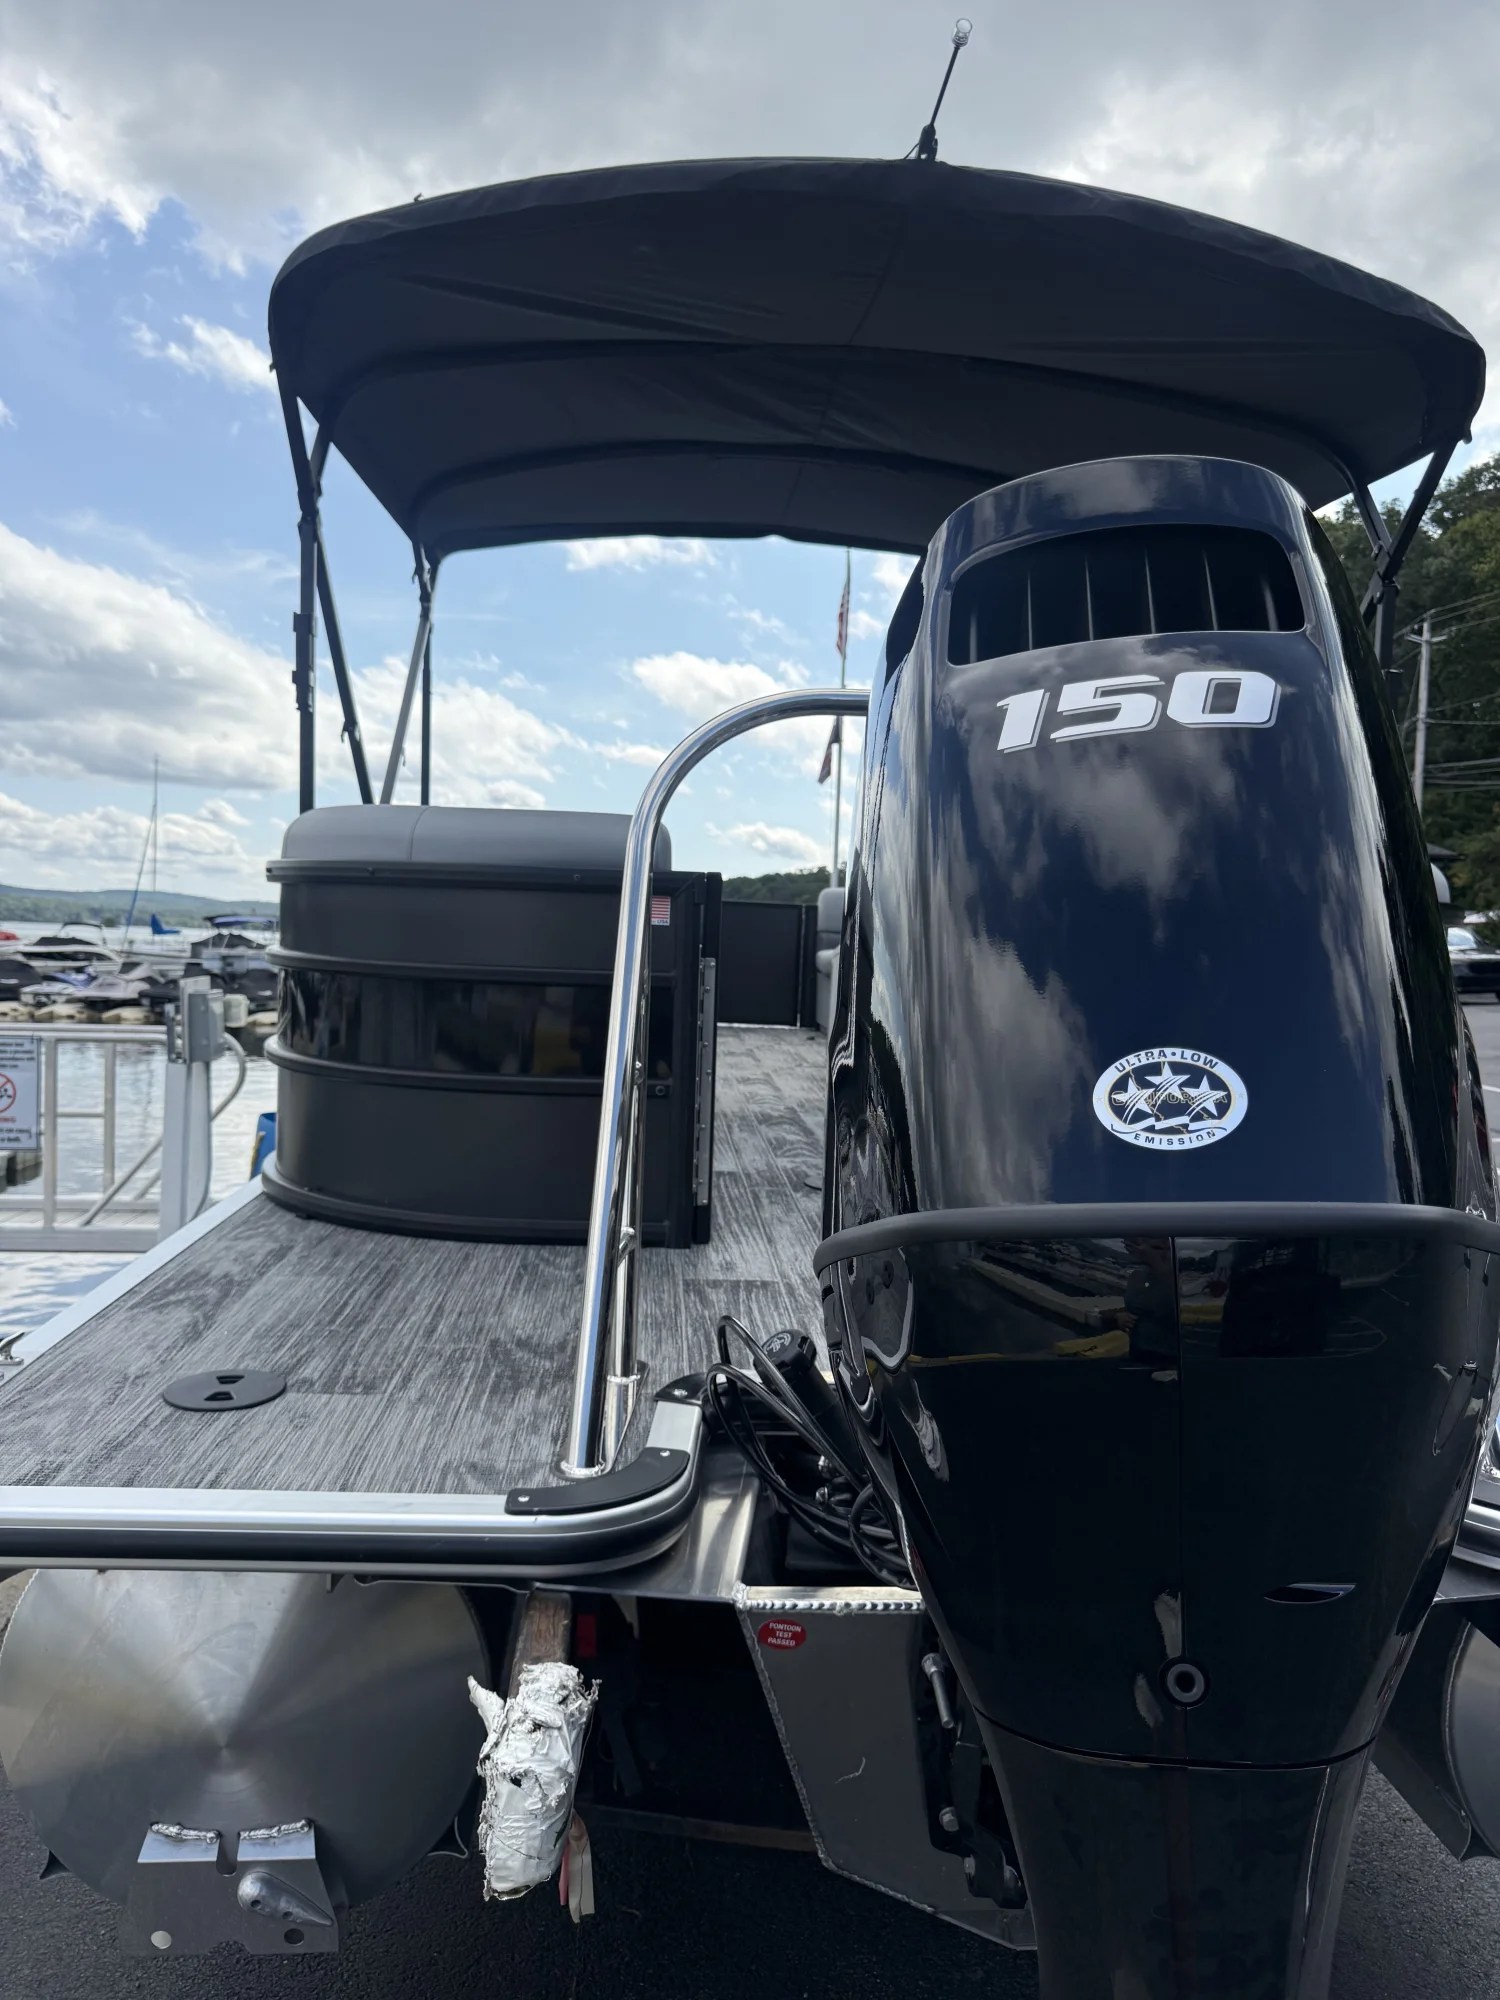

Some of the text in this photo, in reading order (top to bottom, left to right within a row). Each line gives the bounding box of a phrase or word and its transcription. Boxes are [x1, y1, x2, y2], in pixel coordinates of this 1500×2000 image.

[996, 671, 1281, 754] 150
[1114, 1049, 1219, 1073] ULTRA LOW
[1133, 1129, 1216, 1146] EMISSION
[769, 1622, 802, 1632] PONTOON
[775, 1630, 793, 1638] TEST
[767, 1637, 796, 1647] PASSED
